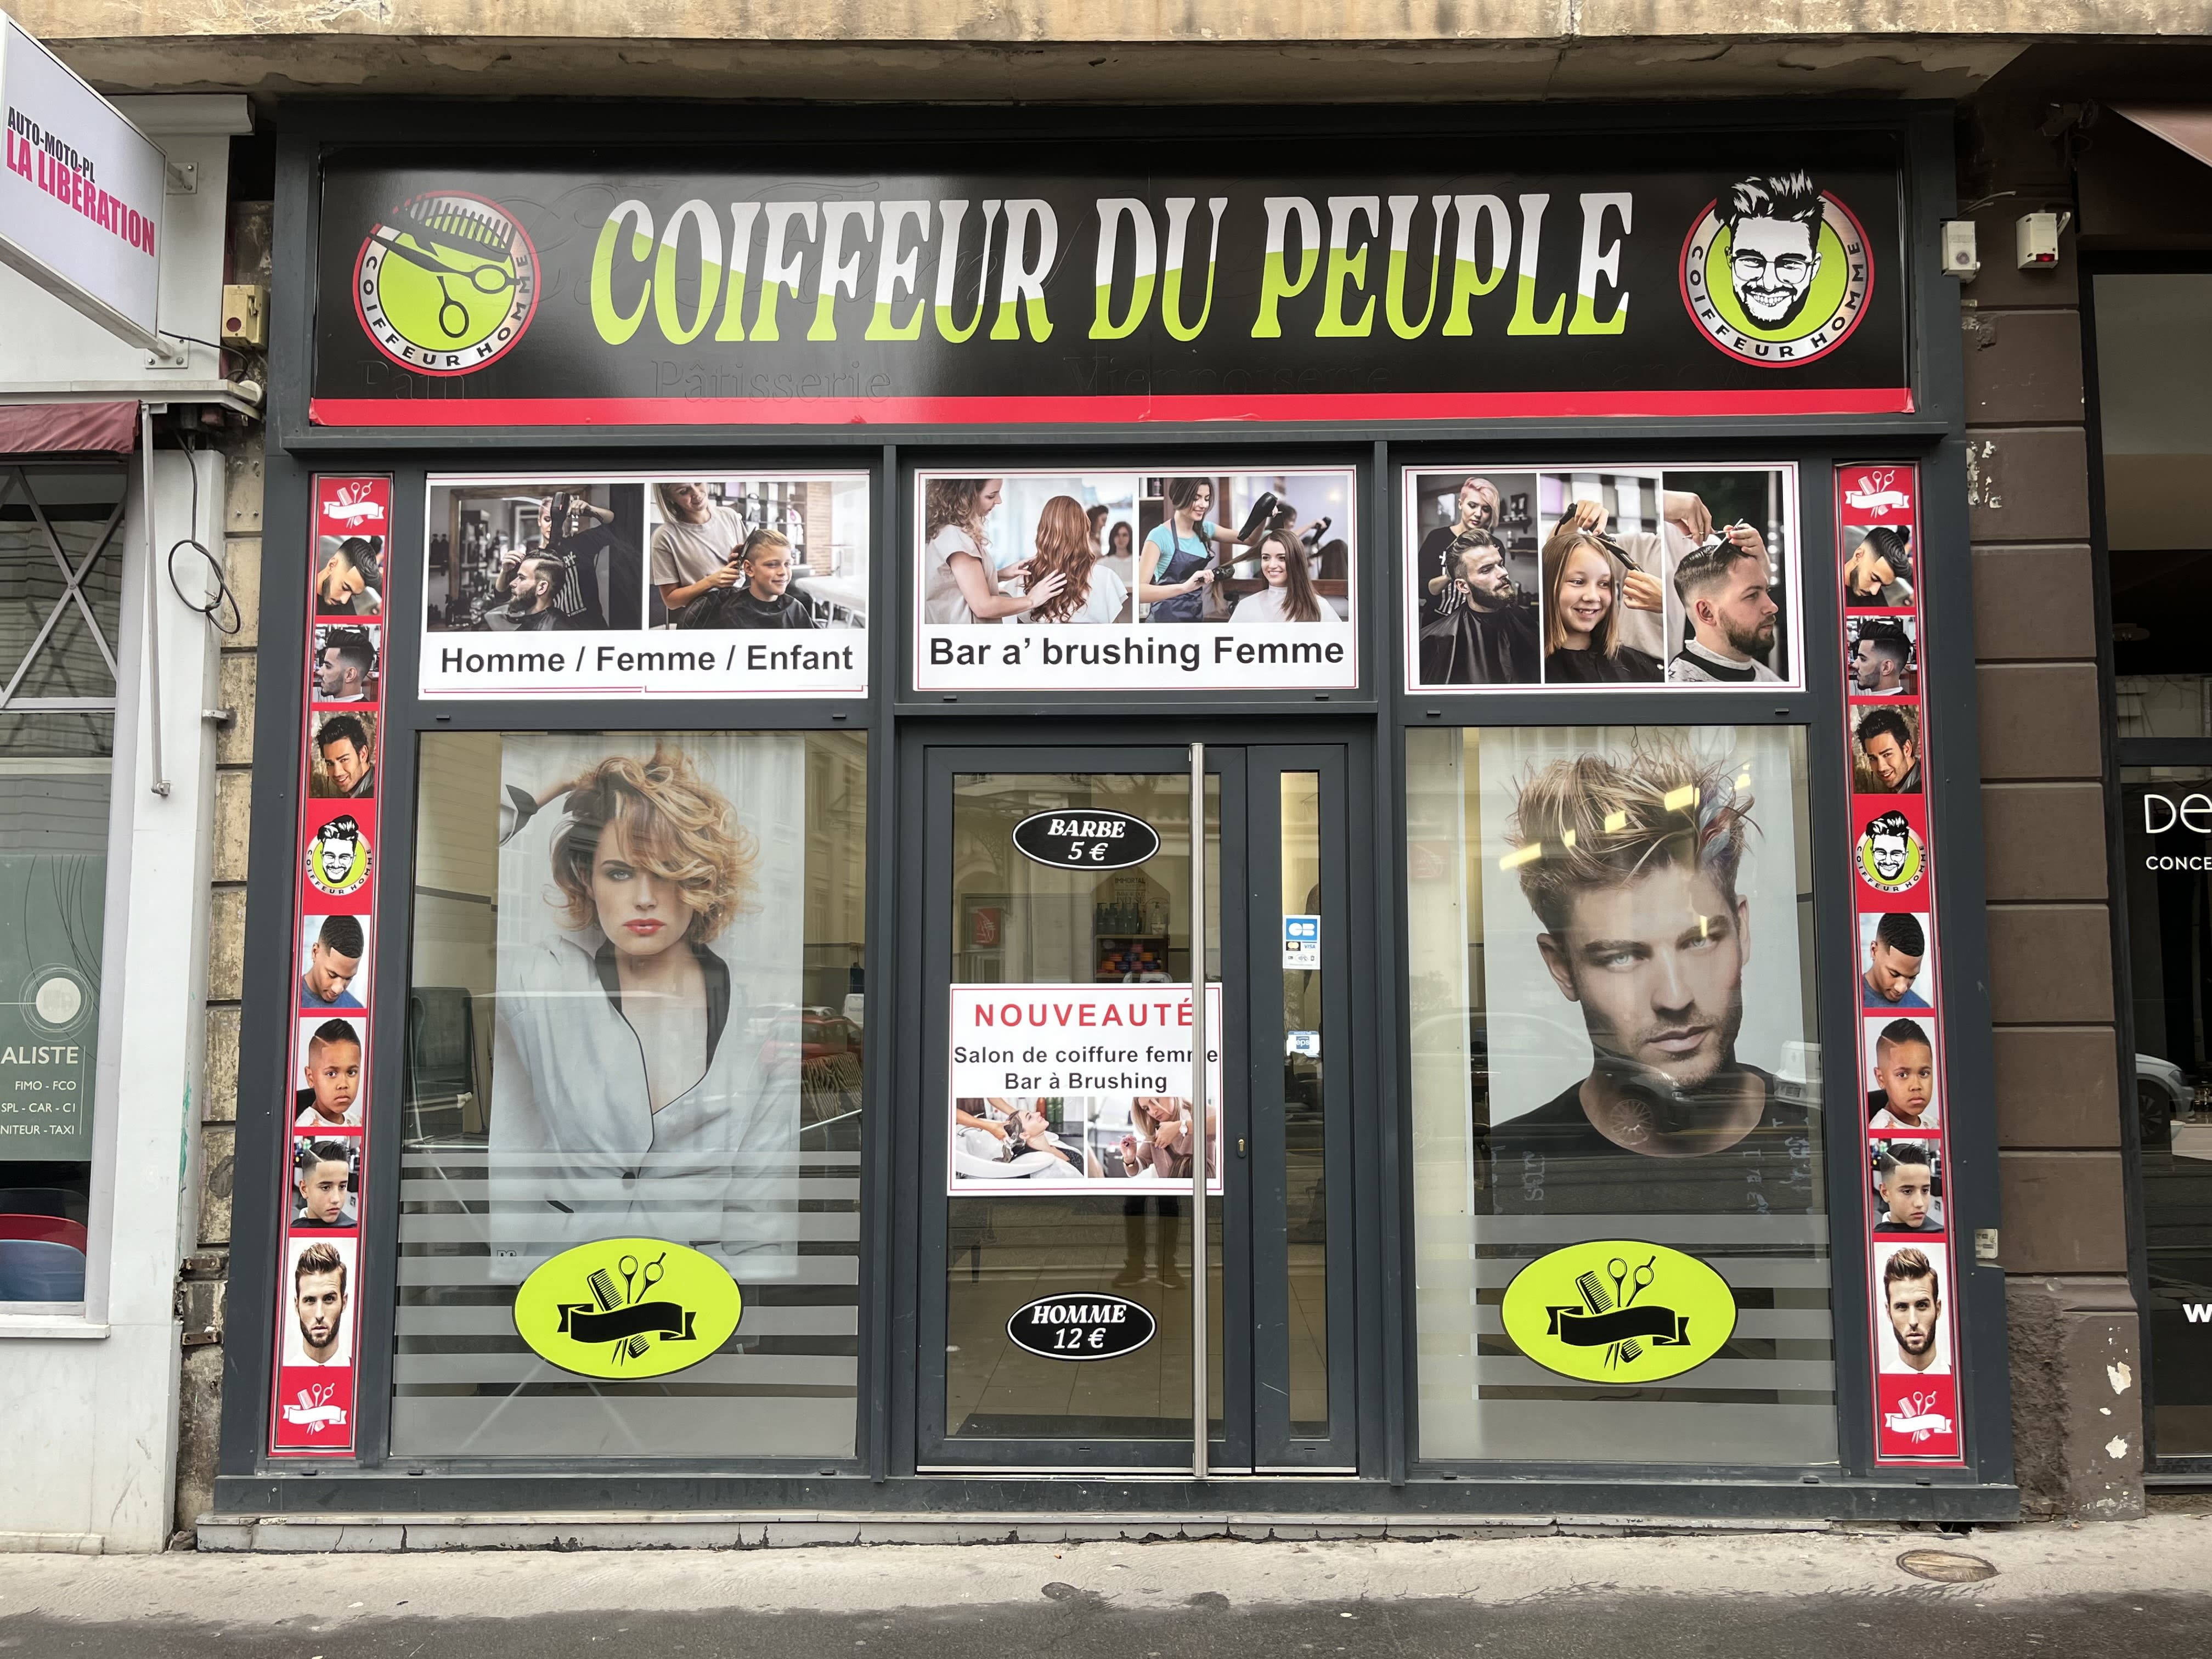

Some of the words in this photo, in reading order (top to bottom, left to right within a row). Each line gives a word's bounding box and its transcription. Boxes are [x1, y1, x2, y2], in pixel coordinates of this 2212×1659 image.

[7, 106, 95, 184] AUTO-MOTO-PL
[7, 128, 33, 183] LA
[38, 149, 155, 257] LIBÉRATION
[590, 198, 1059, 346] COIFFEUR
[1088, 196, 1228, 342] DU
[1251, 192, 1633, 340] PEUPLE
[1690, 245, 1795, 358] COIFFEUR
[1810, 242, 1864, 348] HOMME
[363, 255, 460, 368] COIFFEUR
[477, 255, 531, 358] HOMME
[441, 648, 565, 673] Homme
[575, 646, 586, 672] /
[597, 646, 716, 672] Femme
[726, 645, 736, 671] /
[747, 644, 853, 670] Enfant
[930, 637, 991, 665] Bar
[1043, 636, 1200, 672] brushing
[1214, 636, 1344, 664] Femme
[1047, 818, 1126, 838] BARBE
[1068, 842, 1085, 861] 5
[1088, 842, 1108, 861] €
[306, 850, 345, 894] COIFFEUR
[351, 849, 373, 890] HOMME
[1857, 846, 1899, 891] COIFFEUR
[1905, 846, 1926, 888] HOMME
[2146, 856, 2212, 870] CONCE
[975, 997, 1193, 1027] NOUVEAUTÉ
[0, 1046, 79, 1064] ALISTE
[954, 1046, 1014, 1063] Salon
[1023, 1046, 1047, 1063] de
[1056, 1046, 1138, 1063] coiffure
[1146, 1046, 1218, 1063] feme
[15, 1081, 42, 1091] FIMO
[53, 1081, 76, 1091] FCO
[1005, 1073, 1042, 1090] Bar
[1049, 1072, 1060, 1089] à
[1069, 1072, 1167, 1093] Brushing
[1, 1103, 19, 1113] SPL
[29, 1103, 52, 1113] CAR
[0, 1125, 41, 1135] NITEUR
[49, 1125, 75, 1135] TAXI
[1031, 1305, 1126, 1325] HOMME
[1053, 1328, 1082, 1349] 12
[1088, 1328, 1107, 1349] €
